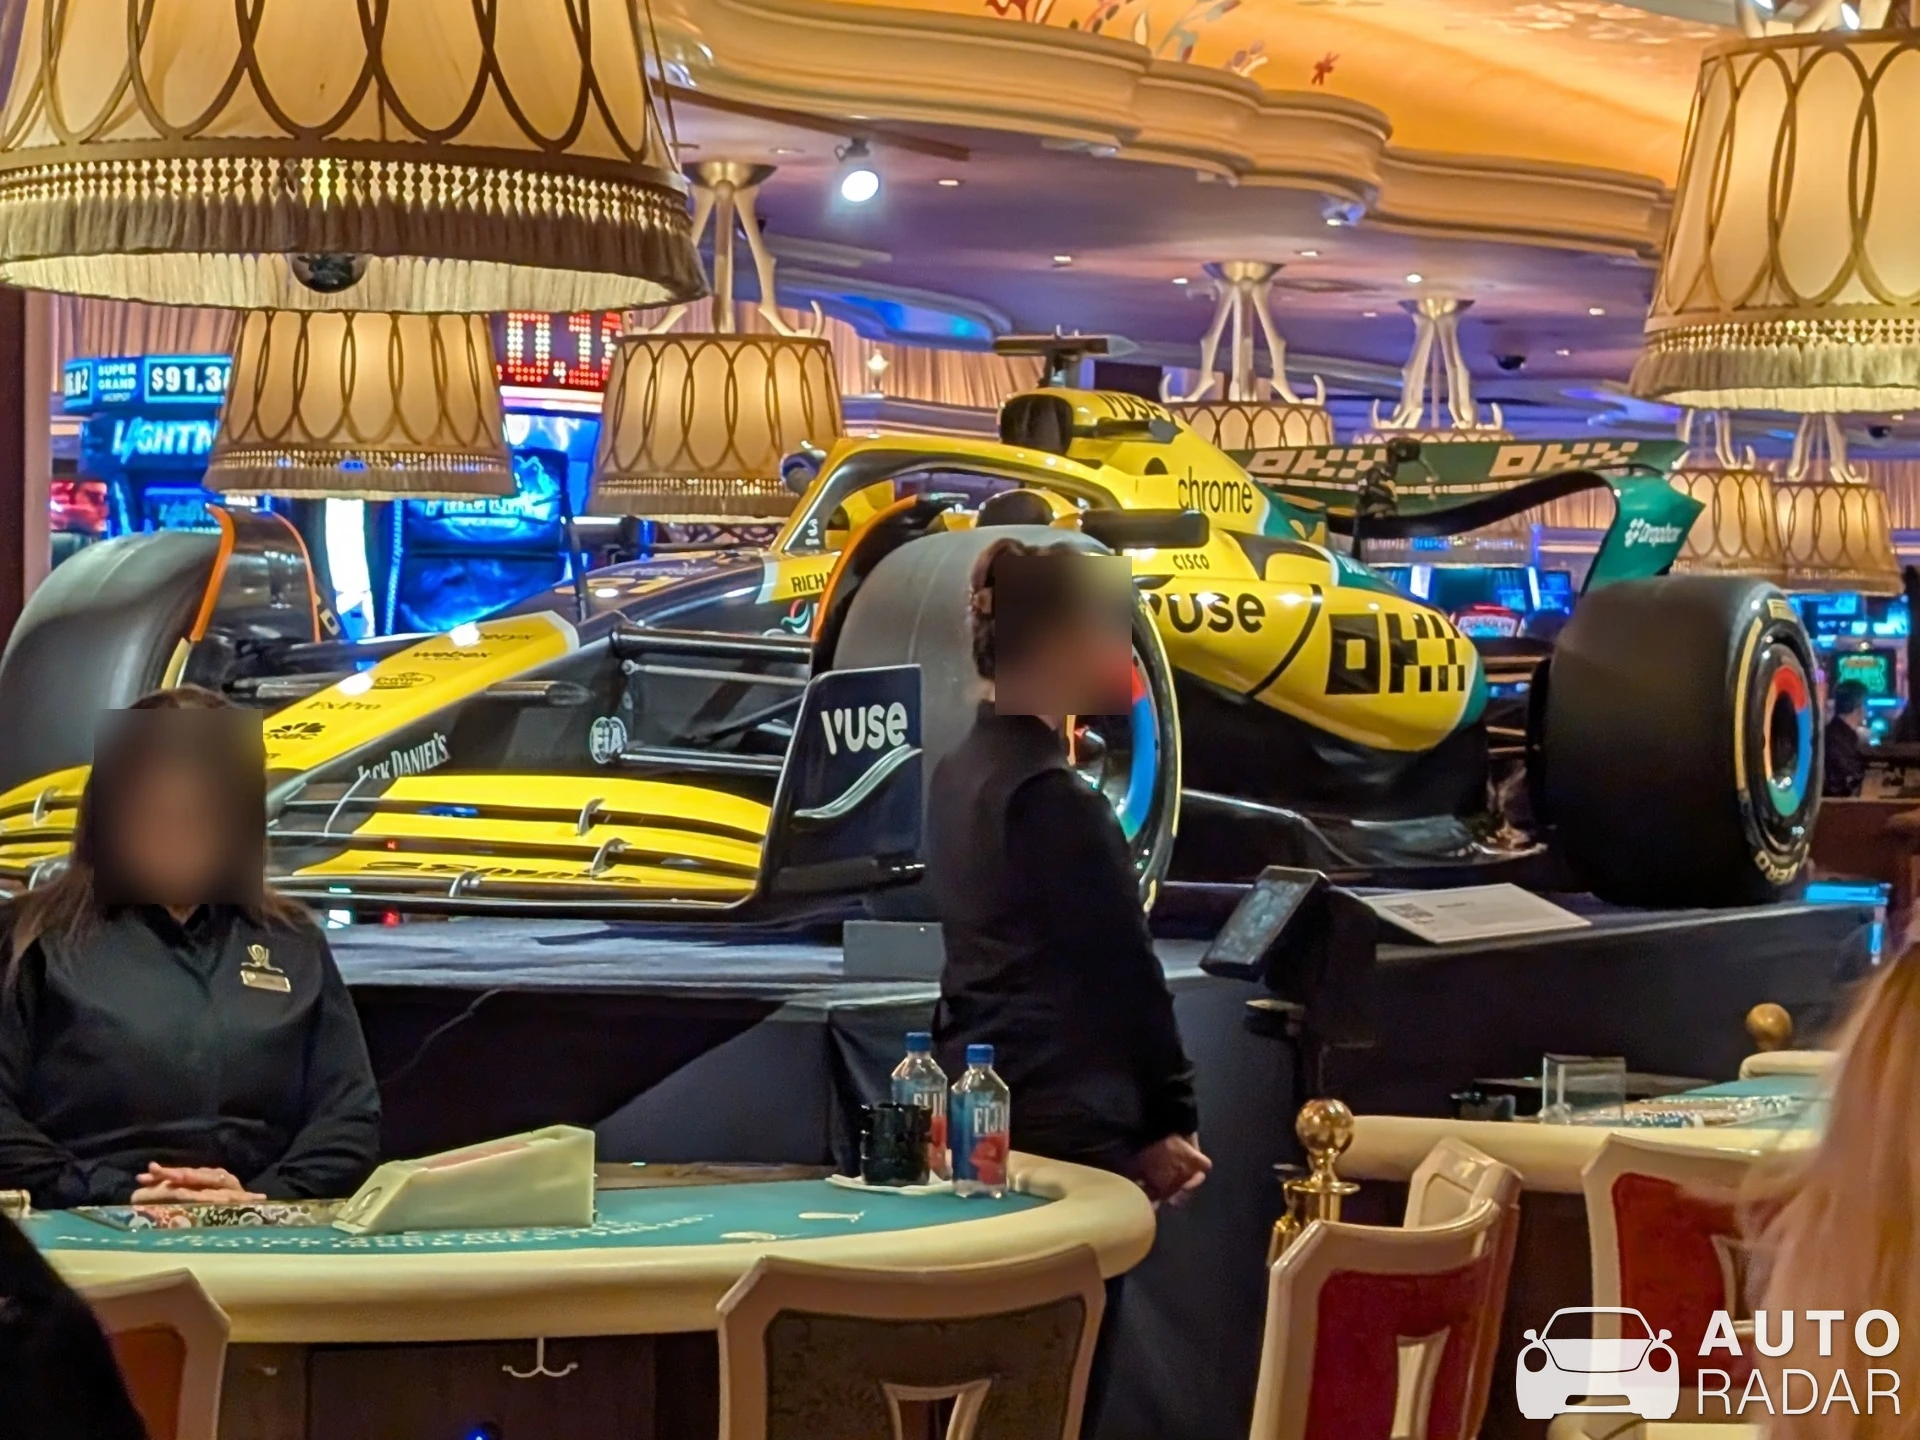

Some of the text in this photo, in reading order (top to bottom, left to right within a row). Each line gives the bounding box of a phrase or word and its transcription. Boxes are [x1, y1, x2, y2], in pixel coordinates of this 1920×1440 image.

[98, 363, 137, 377] SUPER
[98, 377, 137, 391] GRAND
[152, 366, 231, 393] $91.3
[1178, 465, 1253, 514] chrome
[1325, 613, 1465, 695] OKX
[391, 732, 450, 777] DANIEL'S
